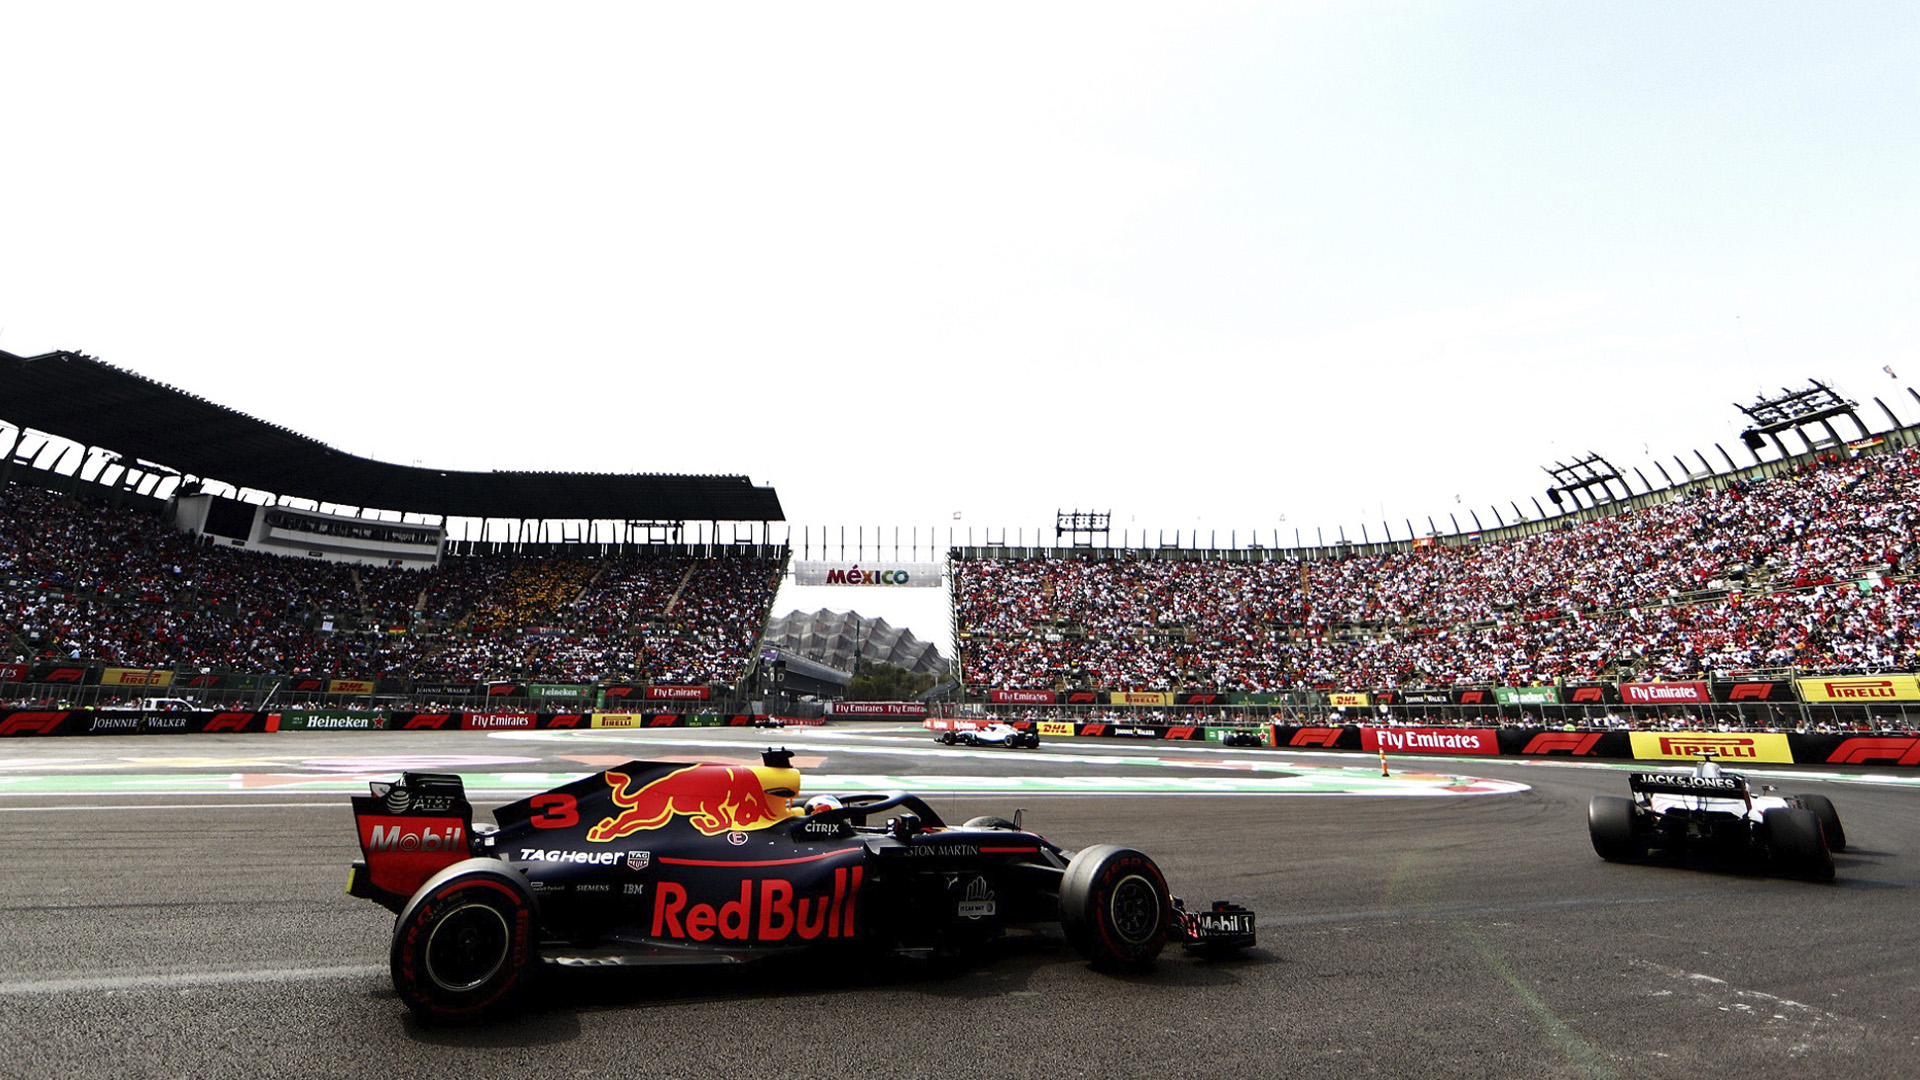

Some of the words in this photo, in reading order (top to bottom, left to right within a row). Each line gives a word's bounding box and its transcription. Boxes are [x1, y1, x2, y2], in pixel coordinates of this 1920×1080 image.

[1630, 686, 1649, 701] Fly
[1649, 686, 1698, 700] Emirates
[1824, 680, 1896, 698] PIRELLI
[1336, 696, 1358, 705] DHL
[835, 704, 850, 714] Fly
[850, 704, 884, 713] Emirates
[888, 704, 901, 714] Fly
[902, 704, 925, 713] Emira
[90, 717, 139, 732] JOHNNIE
[148, 717, 187, 728] WALKER
[306, 715, 369, 728] Heineken
[472, 714, 490, 729] Fly
[489, 714, 529, 727] Emirates
[602, 716, 633, 727] PIRELLI
[1043, 724, 1068, 734] DHL
[1376, 730, 1404, 749] Fly
[1405, 731, 1480, 749] Emirates
[1658, 737, 1757, 758] PIRELLI
[530, 793, 580, 829] 3
[369, 824, 462, 852] Mobil
[904, 845, 936, 857] STON
[938, 844, 978, 856] MARTIN
[575, 884, 610, 892] SIEMENS
[623, 883, 643, 895] IBM
[651, 879, 753, 941] Red
[757, 865, 864, 941] Bull
[1202, 915, 1238, 932] Mobil
